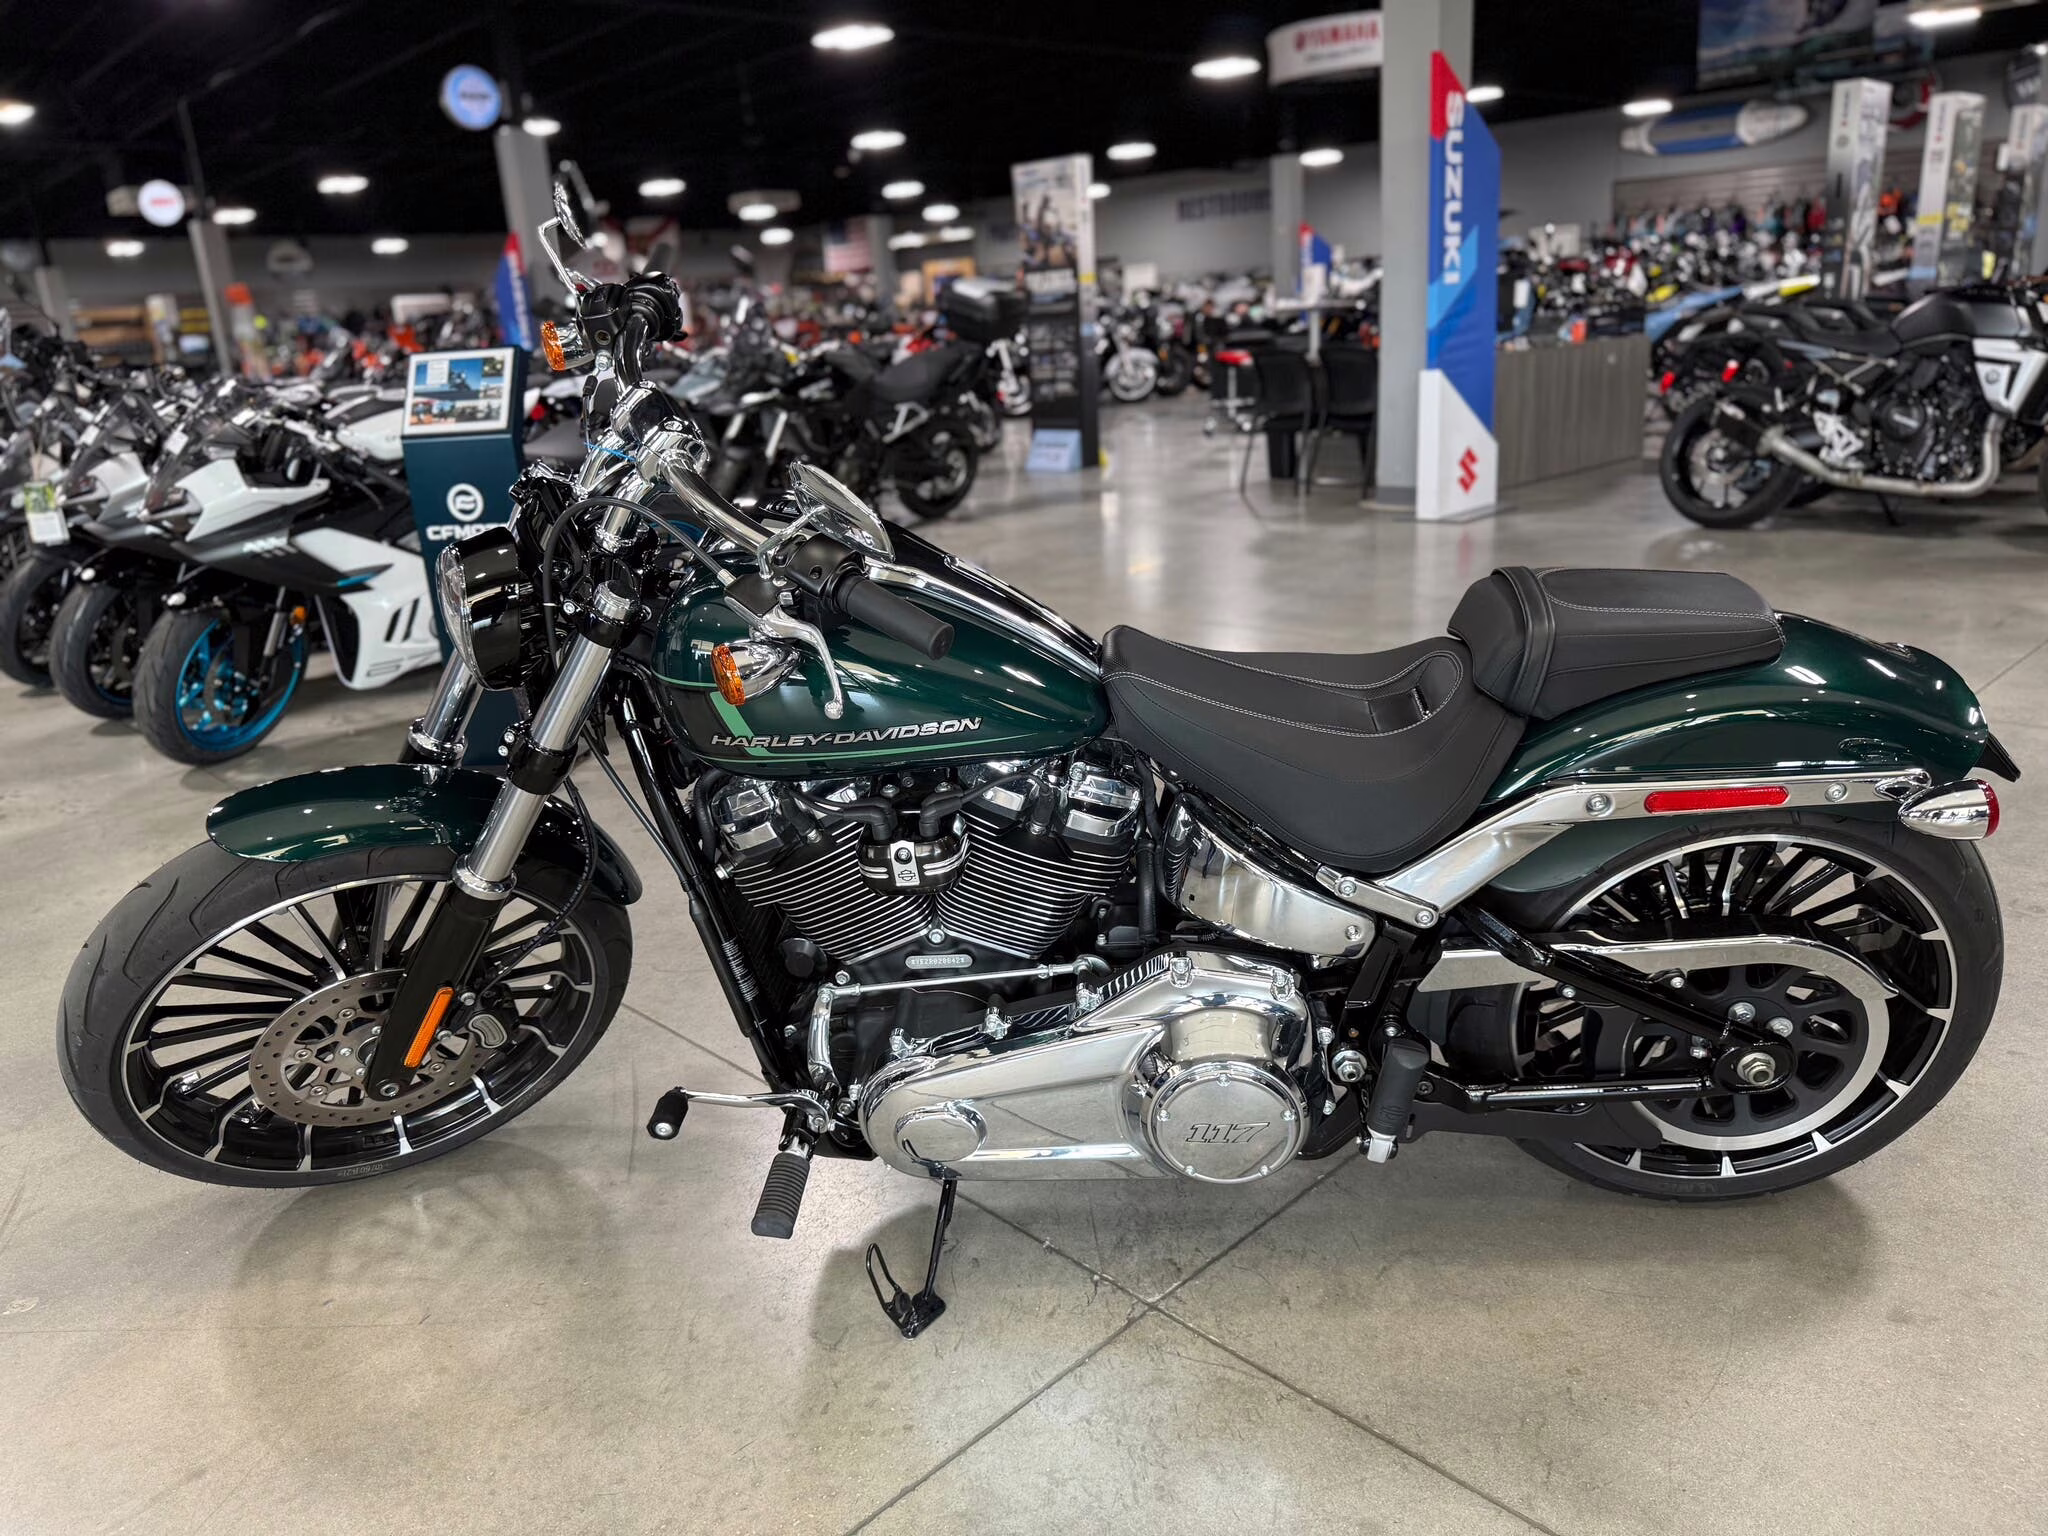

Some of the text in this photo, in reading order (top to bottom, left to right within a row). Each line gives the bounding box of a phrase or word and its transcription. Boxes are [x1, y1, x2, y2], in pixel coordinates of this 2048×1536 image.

[1443, 90, 1465, 286] SUZUKI
[711, 716, 984, 749] HARLEY-DAVIDSON
[1185, 1121, 1271, 1143] 117
